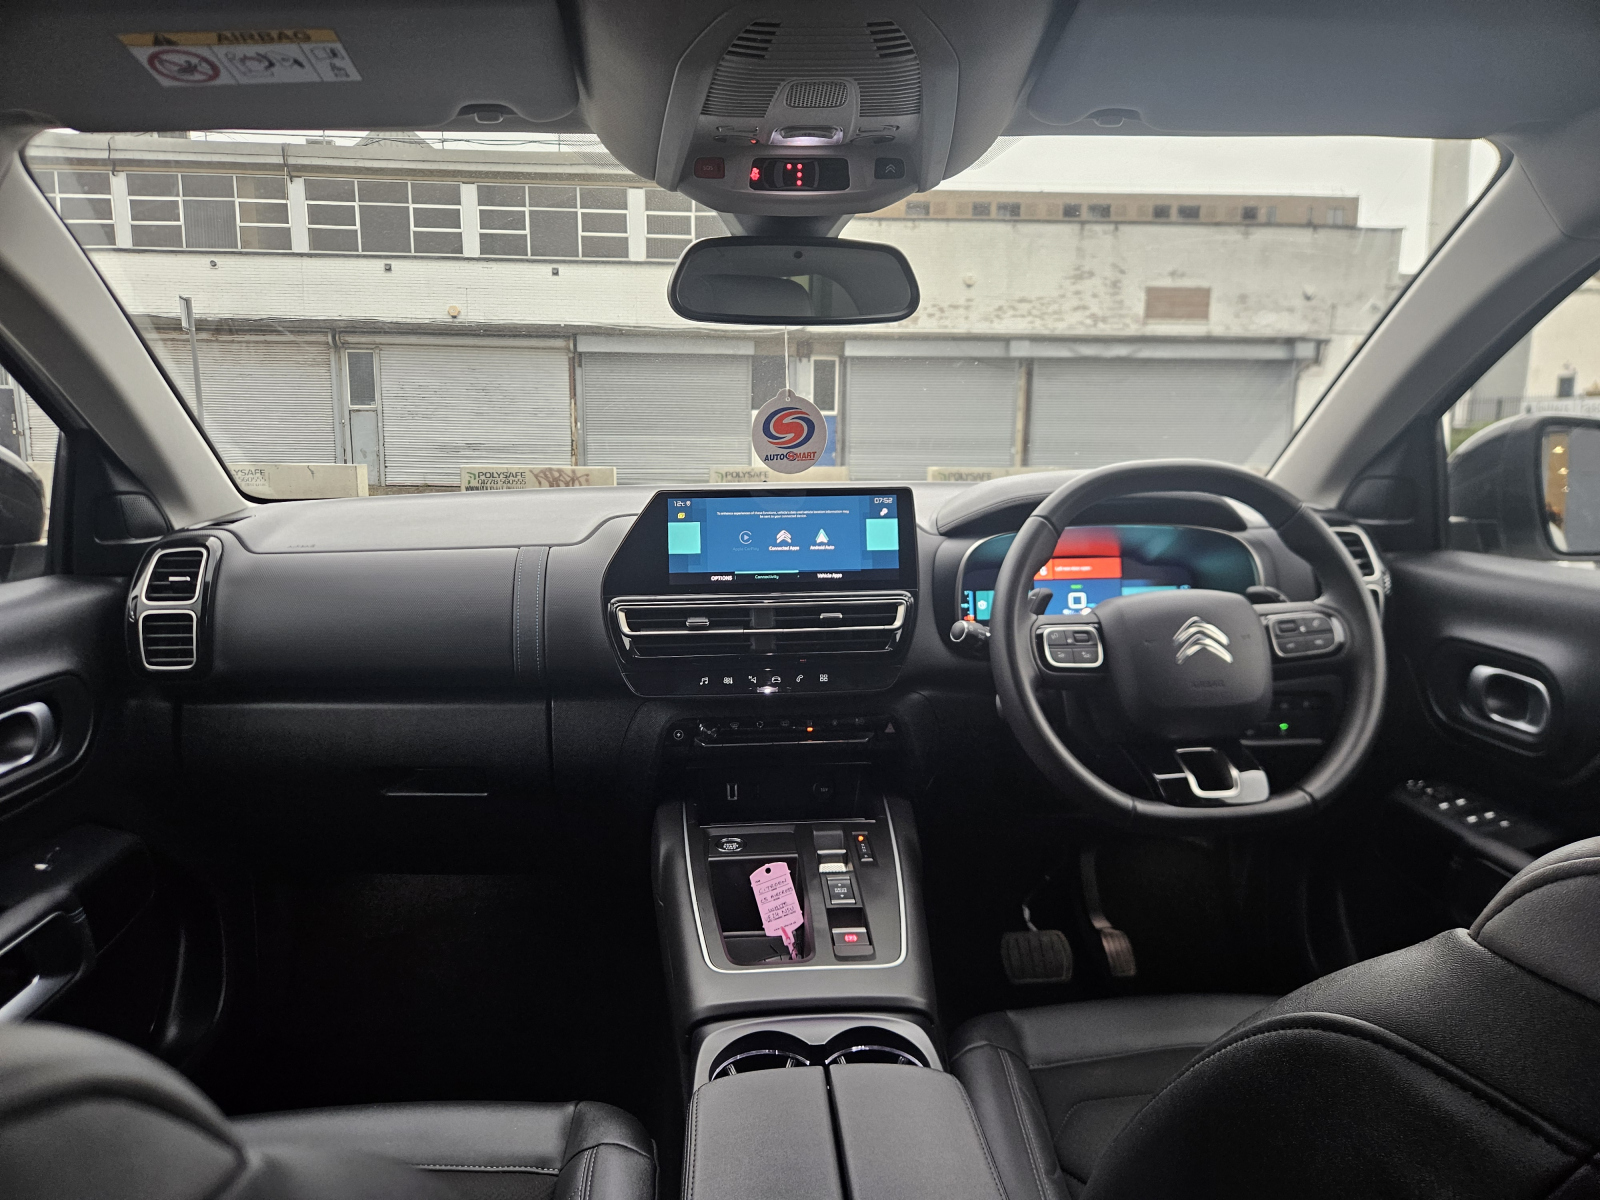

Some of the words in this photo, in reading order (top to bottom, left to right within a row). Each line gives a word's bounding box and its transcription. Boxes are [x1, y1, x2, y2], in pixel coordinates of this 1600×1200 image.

[217, 30, 312, 44] AIRBAG
[477, 471, 527, 479] POLYSAFE
[724, 471, 770, 479] POLYSAFE
